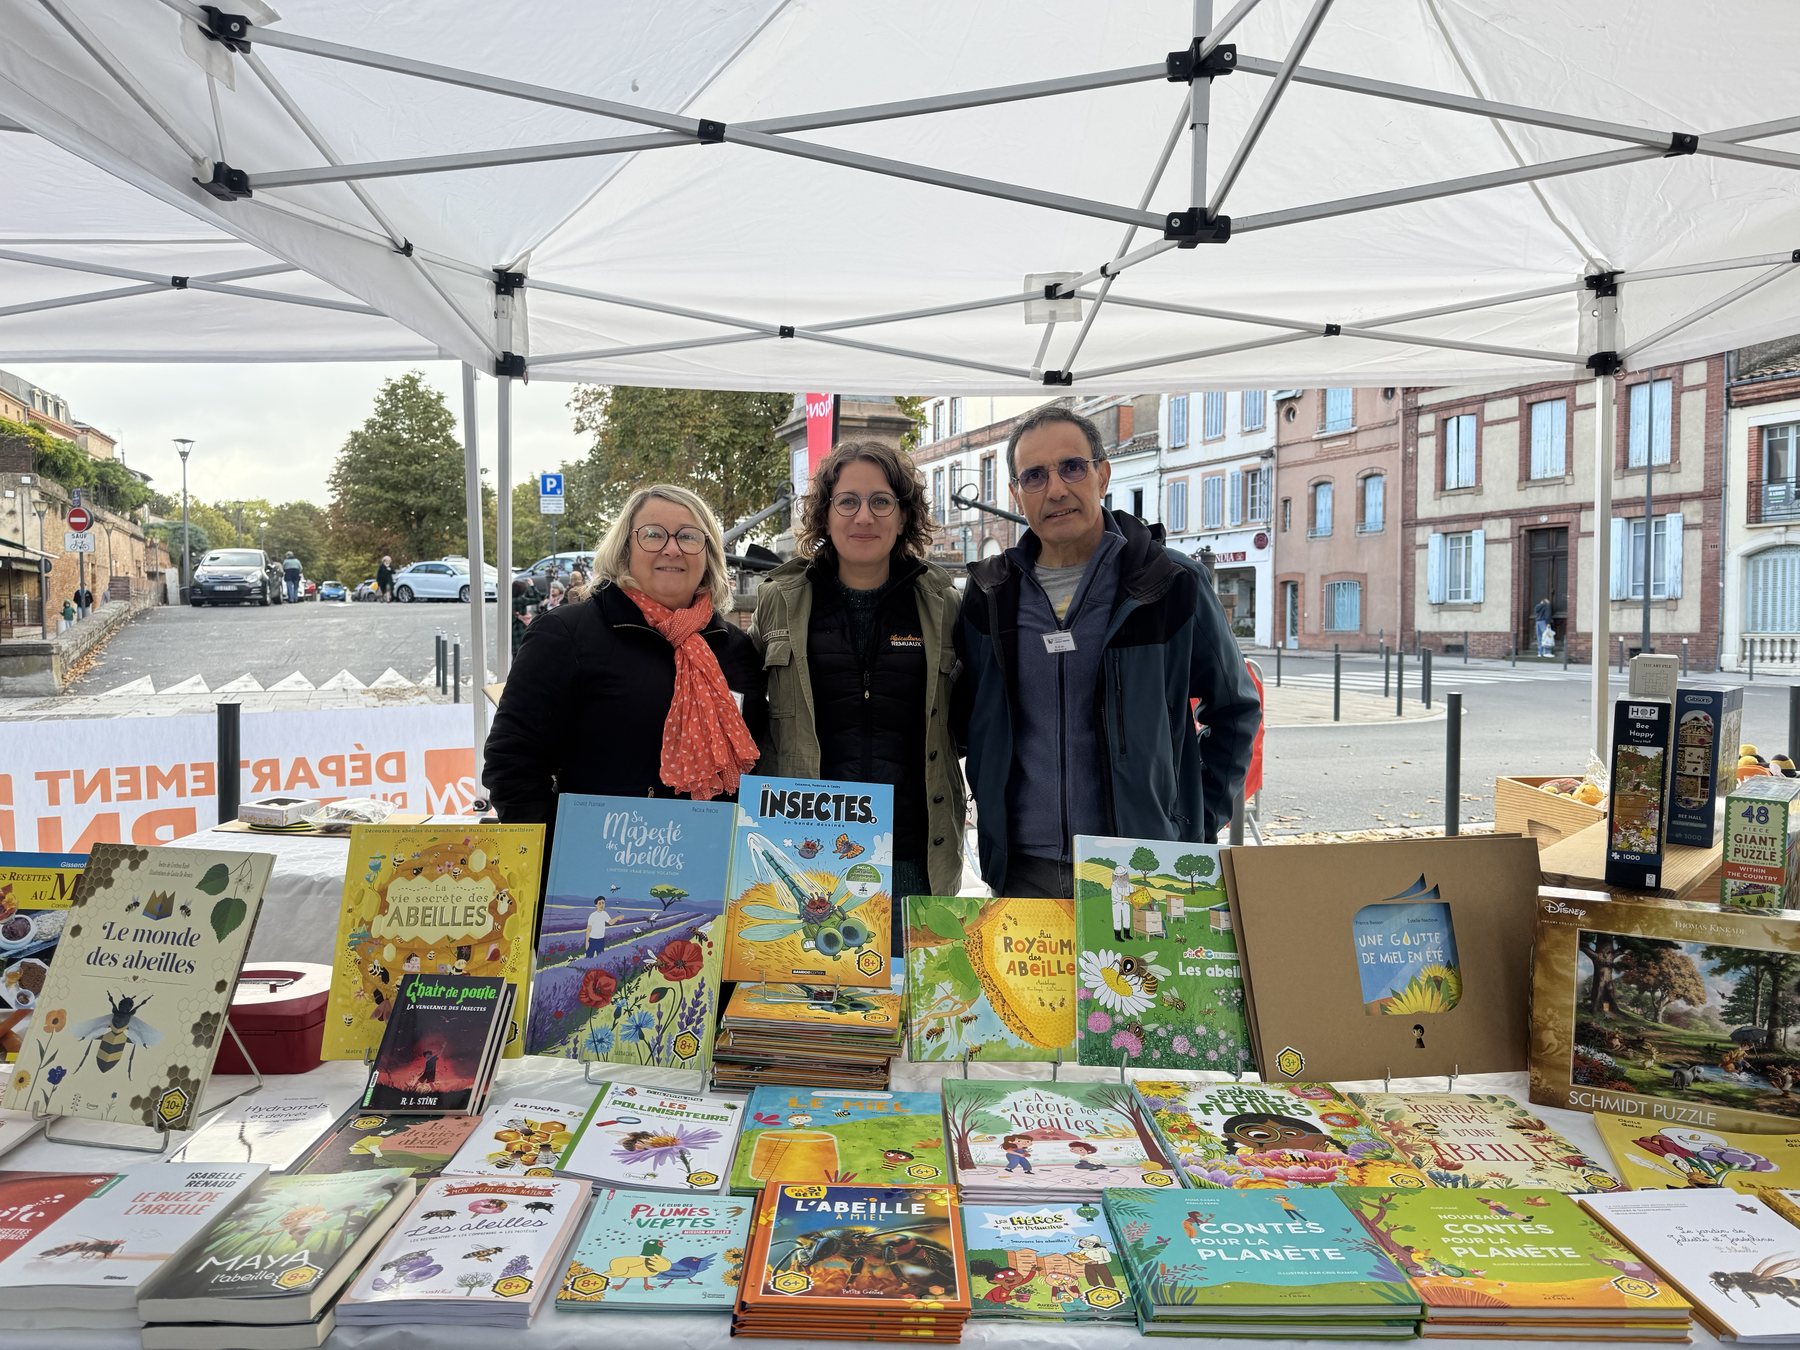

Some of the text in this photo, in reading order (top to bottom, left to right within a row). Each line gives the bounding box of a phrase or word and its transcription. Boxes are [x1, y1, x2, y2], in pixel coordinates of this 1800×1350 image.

[546, 478, 557, 492] P
[1630, 730, 1654, 738] Happy
[632, 810, 643, 823] Sa
[1742, 805, 1769, 824] 48
[603, 812, 683, 847] Majesté
[606, 840, 618, 850] des
[1734, 834, 1777, 847] GIANT
[614, 842, 685, 871] abeilles
[1734, 848, 1776, 861] PUZZLE
[10, 870, 52, 882] RECETTES
[1743, 874, 1778, 882] COUNTRY
[30, 890, 48, 900] AU
[391, 893, 488, 904] vie secrète des
[386, 906, 488, 927] ABEILLES
[1674, 920, 1745, 935] THOMAS KINKADE
[102, 922, 201, 948] Le monde
[1358, 934, 1383, 948] UNE
[86, 947, 197, 975] des abeilles
[1362, 946, 1444, 965] DE EN ÉTÉ
[864, 958, 876, 968] 8+
[1178, 961, 1201, 977] Les
[446, 988, 458, 998] de
[680, 1041, 692, 1050] 8+
[1284, 1058, 1296, 1068] 3+
[164, 1100, 181, 1110] 10+
[400, 1097, 408, 1105] R.
[659, 1101, 688, 1110] LES
[788, 1097, 824, 1108] LE
[1205, 1095, 1287, 1104] SECRET
[244, 1102, 330, 1114] Hydromels
[529, 1105, 560, 1113] ruche
[611, 1098, 730, 1122] POLLINISATEURS
[1198, 1104, 1314, 1116] FLEURS
[1406, 1104, 1494, 1116] JOURNAL
[1568, 1091, 1648, 1116] SCHMIDT
[1653, 1105, 1717, 1127] PUZZLE
[1420, 1114, 1497, 1124] INTIME
[1451, 1128, 1502, 1138] D'UNE
[1434, 1143, 1553, 1162] ABEILLE
[916, 1168, 930, 1176] 6+
[132, 1192, 224, 1202] LE BUZZ DE
[124, 1204, 210, 1216] L'ABEILLE
[630, 1204, 710, 1220] PLUMES
[795, 1200, 926, 1216] L'ABEILLE
[636, 1218, 716, 1229] VERTES
[850, 1213, 886, 1222] MIEL
[1010, 1214, 1066, 1226] HÉROS
[404, 1217, 548, 1237] Les abeilles
[1198, 1222, 1326, 1235] CONTES
[1443, 1224, 1554, 1234] CONTES
[1190, 1238, 1270, 1246] POUR LA
[1197, 1245, 1346, 1260] PLANÈTE
[1450, 1244, 1582, 1258] PLANÈTE
[196, 1250, 311, 1274] MAYA
[210, 1270, 276, 1284] l'abeille
[285, 1272, 306, 1282] 8+
[502, 1282, 521, 1290] 8+
[580, 1280, 598, 1288] 8+
[784, 1279, 800, 1288] 6+
[1627, 1282, 1642, 1290] 6+
